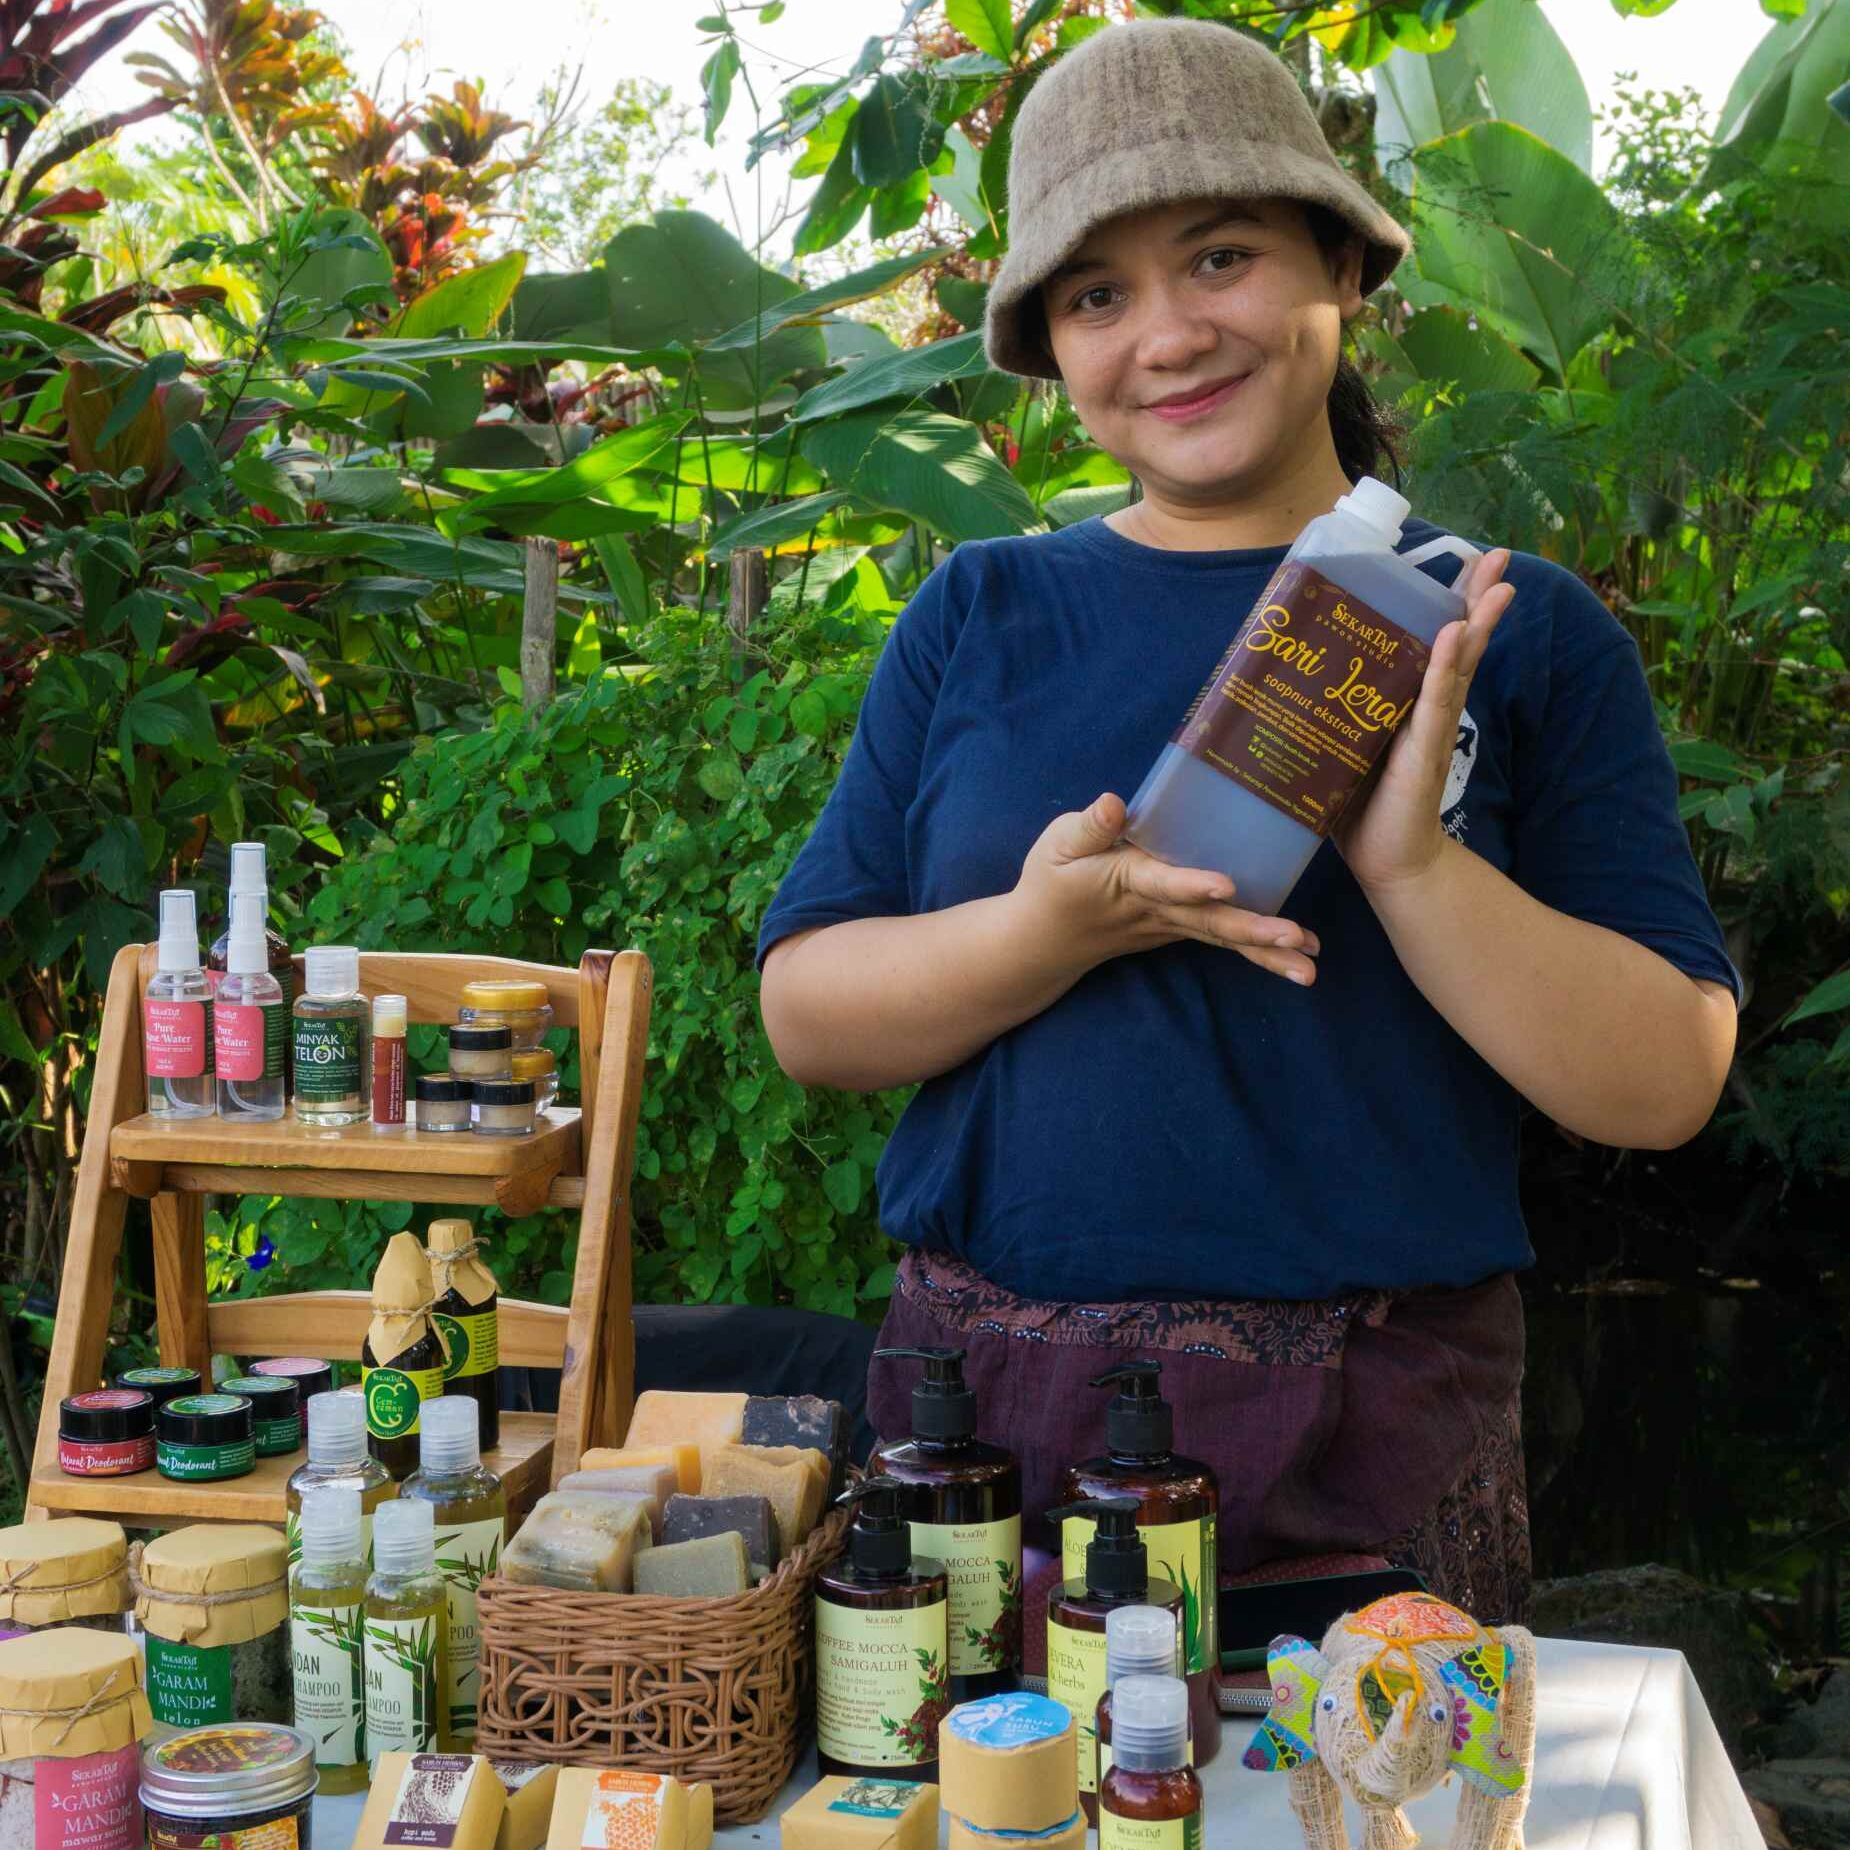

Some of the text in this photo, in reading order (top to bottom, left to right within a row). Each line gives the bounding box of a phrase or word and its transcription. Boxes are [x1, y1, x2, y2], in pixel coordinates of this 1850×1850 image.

[1246, 604, 1327, 676] Sari
[1263, 673, 1362, 742] soapnut ekstract
[153, 1022, 175, 1032] Pure
[160, 1034, 192, 1044] Water
[223, 1036, 249, 1047] Water
[296, 1034, 340, 1045] MINYAK
[294, 1045, 345, 1064] TELON
[86, 1454, 134, 1470] Deodorant
[170, 1456, 216, 1471] Deodorant
[946, 1557, 991, 1568] MOCCA
[858, 1643, 909, 1655] MOCCA
[830, 1654, 909, 1672] SAMIGALUH
[157, 1671, 207, 1691] GARAM
[159, 1691, 206, 1710] MANDI
[164, 1711, 200, 1725] telon
[62, 1781, 127, 1812] GARAM
[65, 1804, 126, 1835] MANDI
[63, 1831, 104, 1848] mawar
